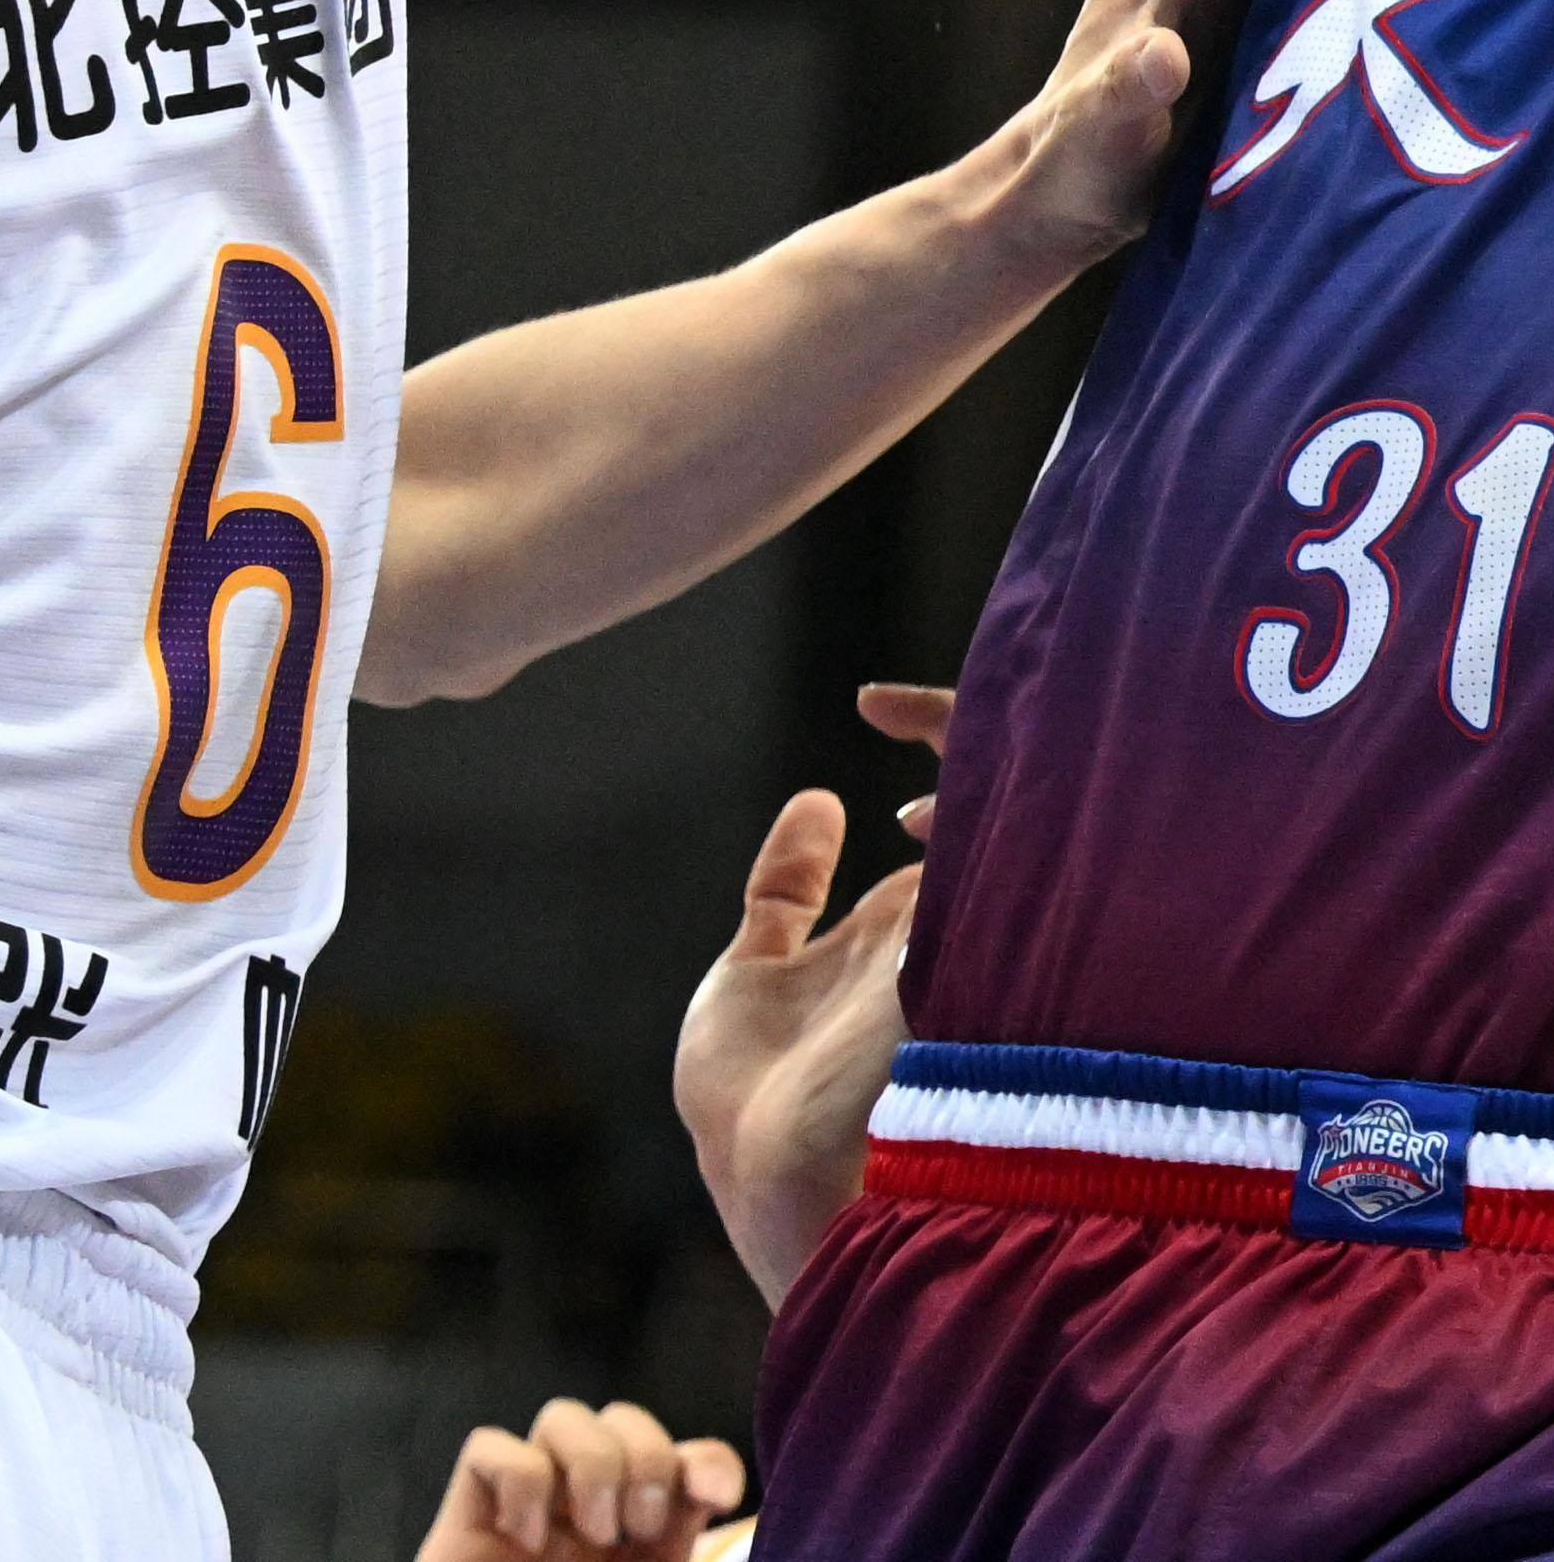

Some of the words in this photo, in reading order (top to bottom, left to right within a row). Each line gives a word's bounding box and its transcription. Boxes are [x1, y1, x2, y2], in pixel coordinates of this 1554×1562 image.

[129, 243, 344, 901] 6
[1313, 1126, 1443, 1188] PIONEERS
[1337, 1161, 1409, 1178] TIANJIN
